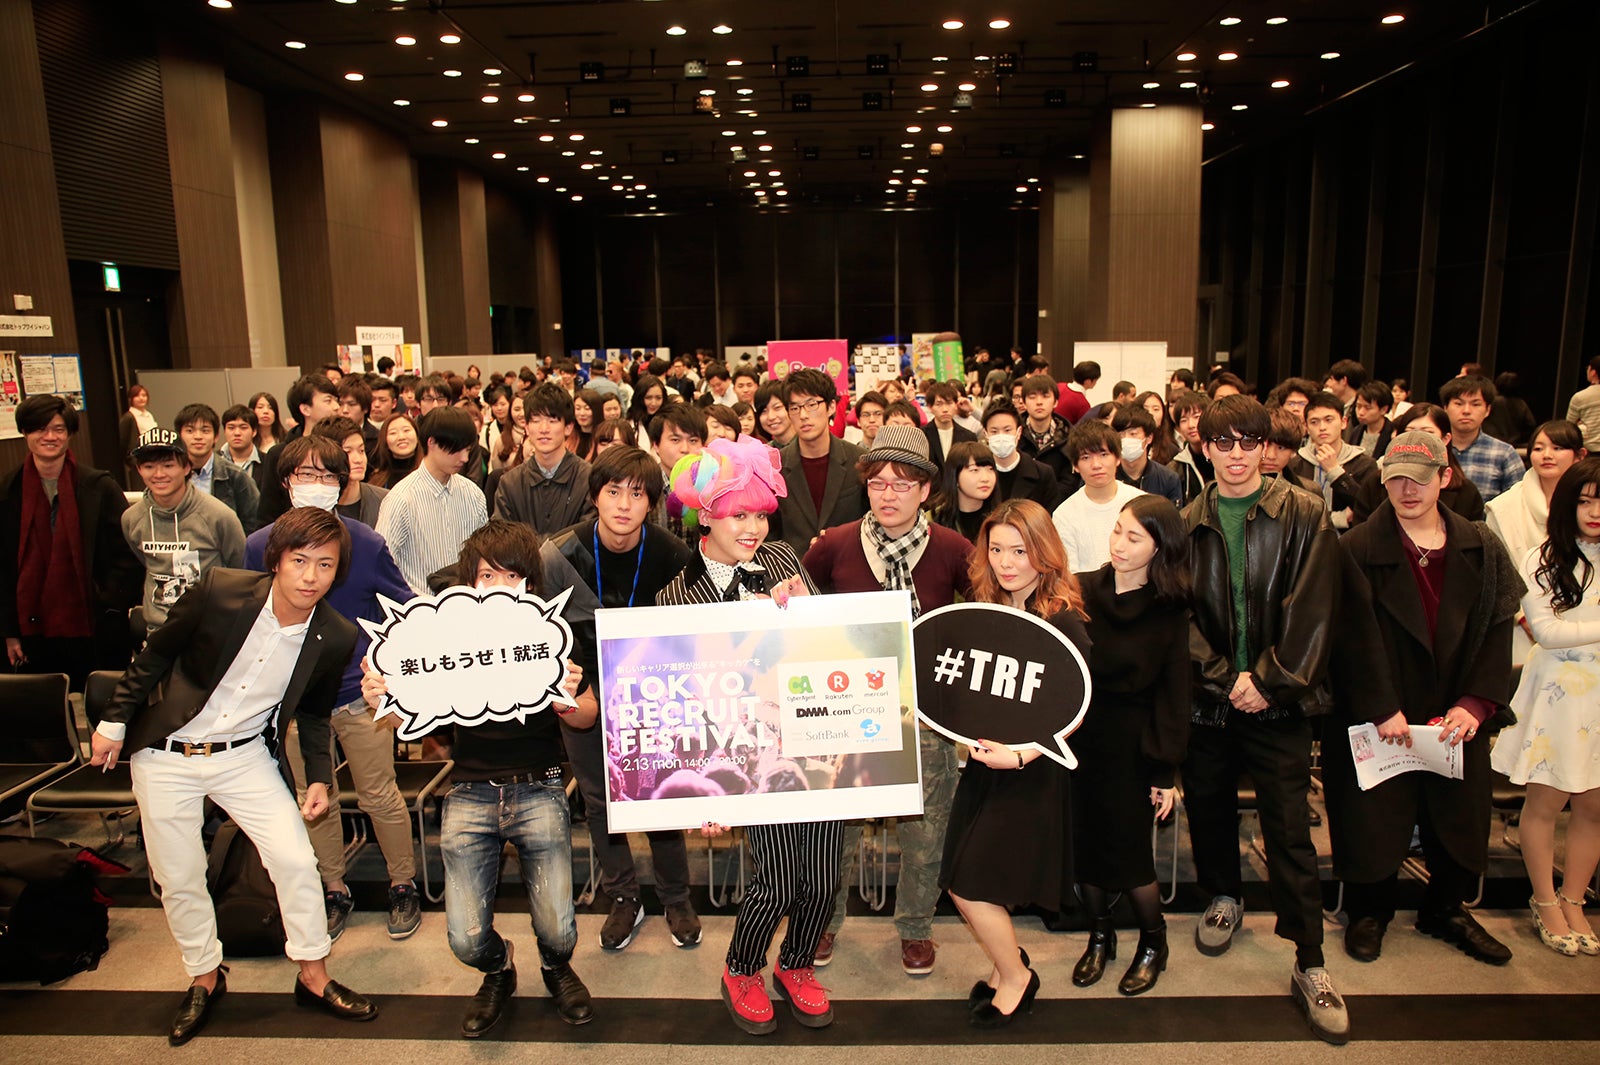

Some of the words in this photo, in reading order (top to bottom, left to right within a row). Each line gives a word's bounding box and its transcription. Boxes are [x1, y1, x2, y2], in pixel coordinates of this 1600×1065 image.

[139, 428, 178, 447] TNHCP
[400, 642, 550, 676] 楽しもうぜ！就活
[616, 671, 745, 702] TOKYO
[933, 647, 1046, 704] #TRF
[825, 693, 854, 701] Rakuten
[618, 695, 761, 729] RECRUIT
[852, 704, 885, 717] Group
[620, 721, 774, 755] FESTIVAL
[805, 730, 850, 742] SoftBank
[622, 757, 650, 772] 2.13
[652, 758, 682, 770] mon
